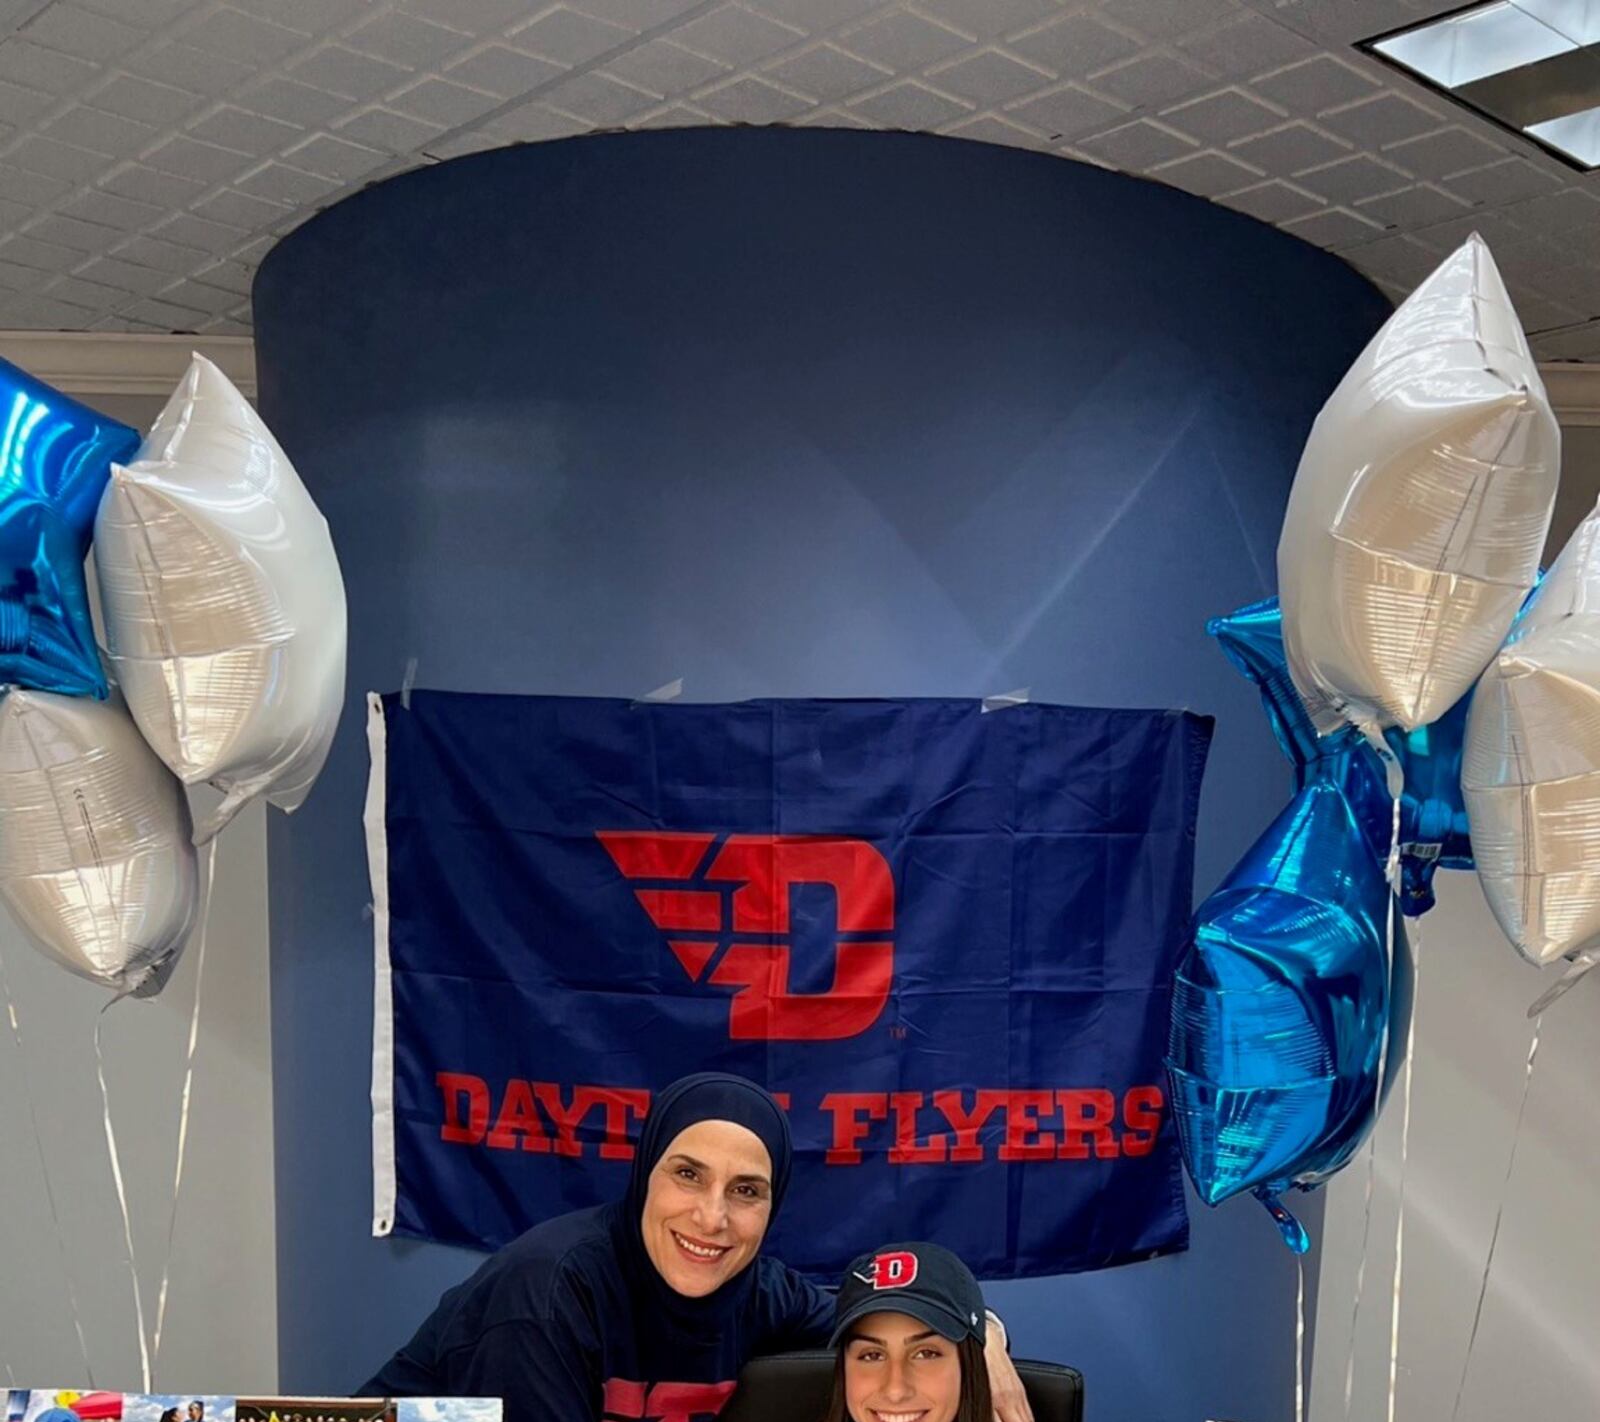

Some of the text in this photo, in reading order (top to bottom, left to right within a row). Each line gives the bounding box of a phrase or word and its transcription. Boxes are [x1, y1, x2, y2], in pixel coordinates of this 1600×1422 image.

[436, 1071, 1164, 1165] DAYT FLYERS
[872, 1251, 919, 1291] D
